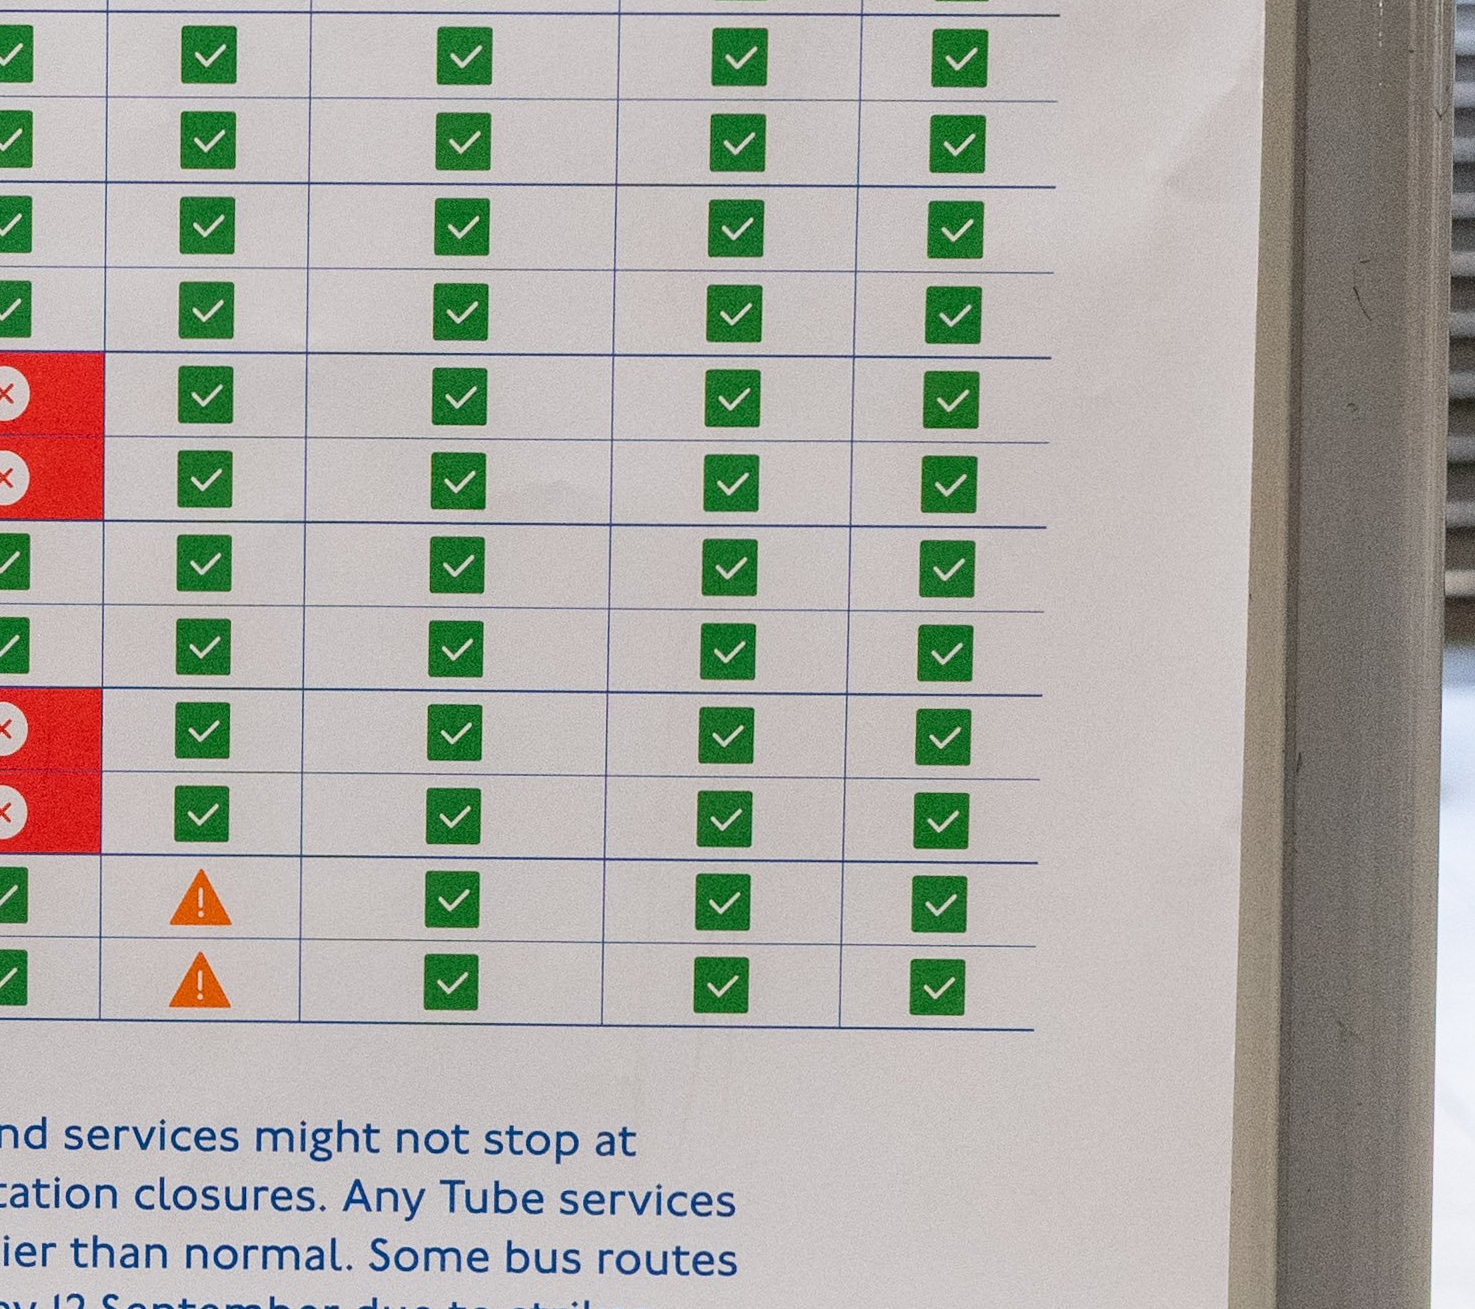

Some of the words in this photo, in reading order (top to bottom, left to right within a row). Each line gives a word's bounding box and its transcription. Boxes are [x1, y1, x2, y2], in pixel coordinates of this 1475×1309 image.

[64, 1120, 240, 1153] services
[255, 1120, 379, 1162] might
[396, 1125, 469, 1155] not
[485, 1125, 579, 1163] stop
[595, 1127, 634, 1157] at
